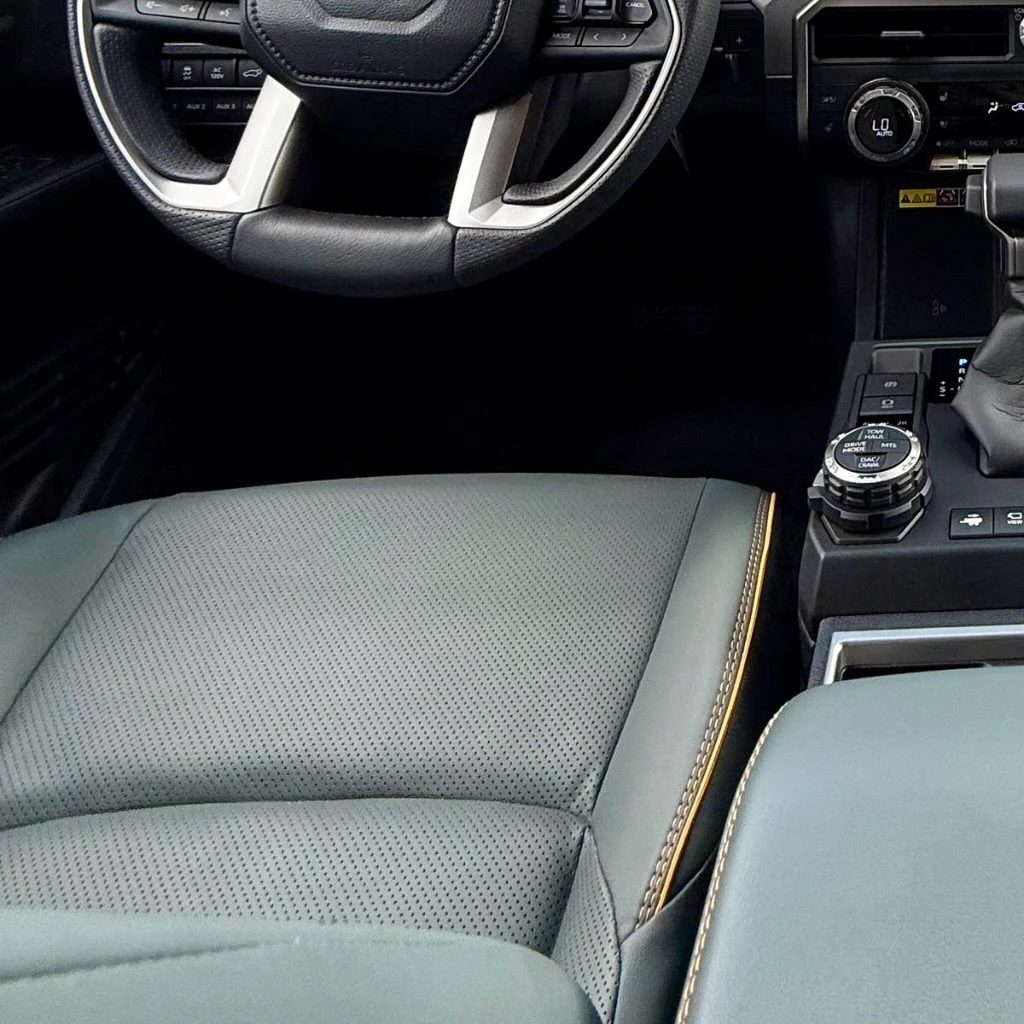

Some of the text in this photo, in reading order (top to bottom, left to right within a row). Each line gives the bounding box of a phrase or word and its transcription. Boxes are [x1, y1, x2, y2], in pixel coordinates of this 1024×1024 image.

[872, 118, 889, 131] LO
[959, 358, 968, 366] P
[844, 440, 867, 448] DRIVE
